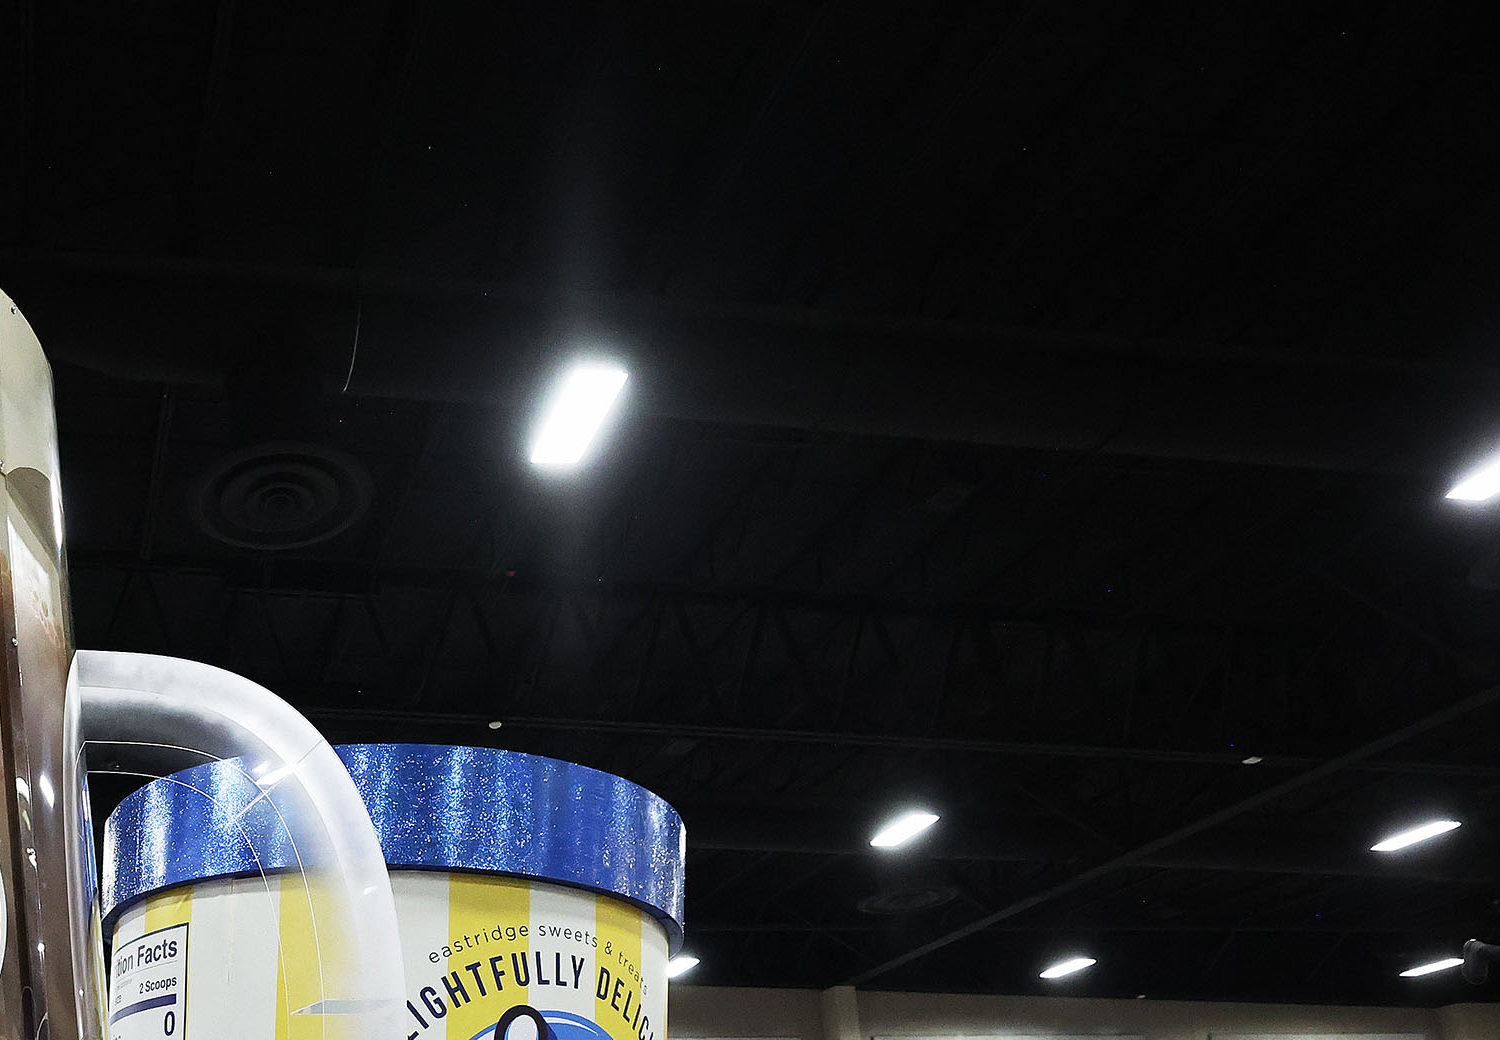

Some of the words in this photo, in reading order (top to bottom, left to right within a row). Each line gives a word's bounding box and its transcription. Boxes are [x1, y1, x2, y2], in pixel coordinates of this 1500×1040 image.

[137, 939, 178, 967] Facts
[428, 924, 530, 964] eastridge
[538, 924, 599, 948] sweets
[604, 941, 612, 955] &
[618, 952, 648, 996] treats
[139, 982, 144, 994] 2
[145, 976, 177, 993] Scoops
[164, 1011, 176, 1036] 0
